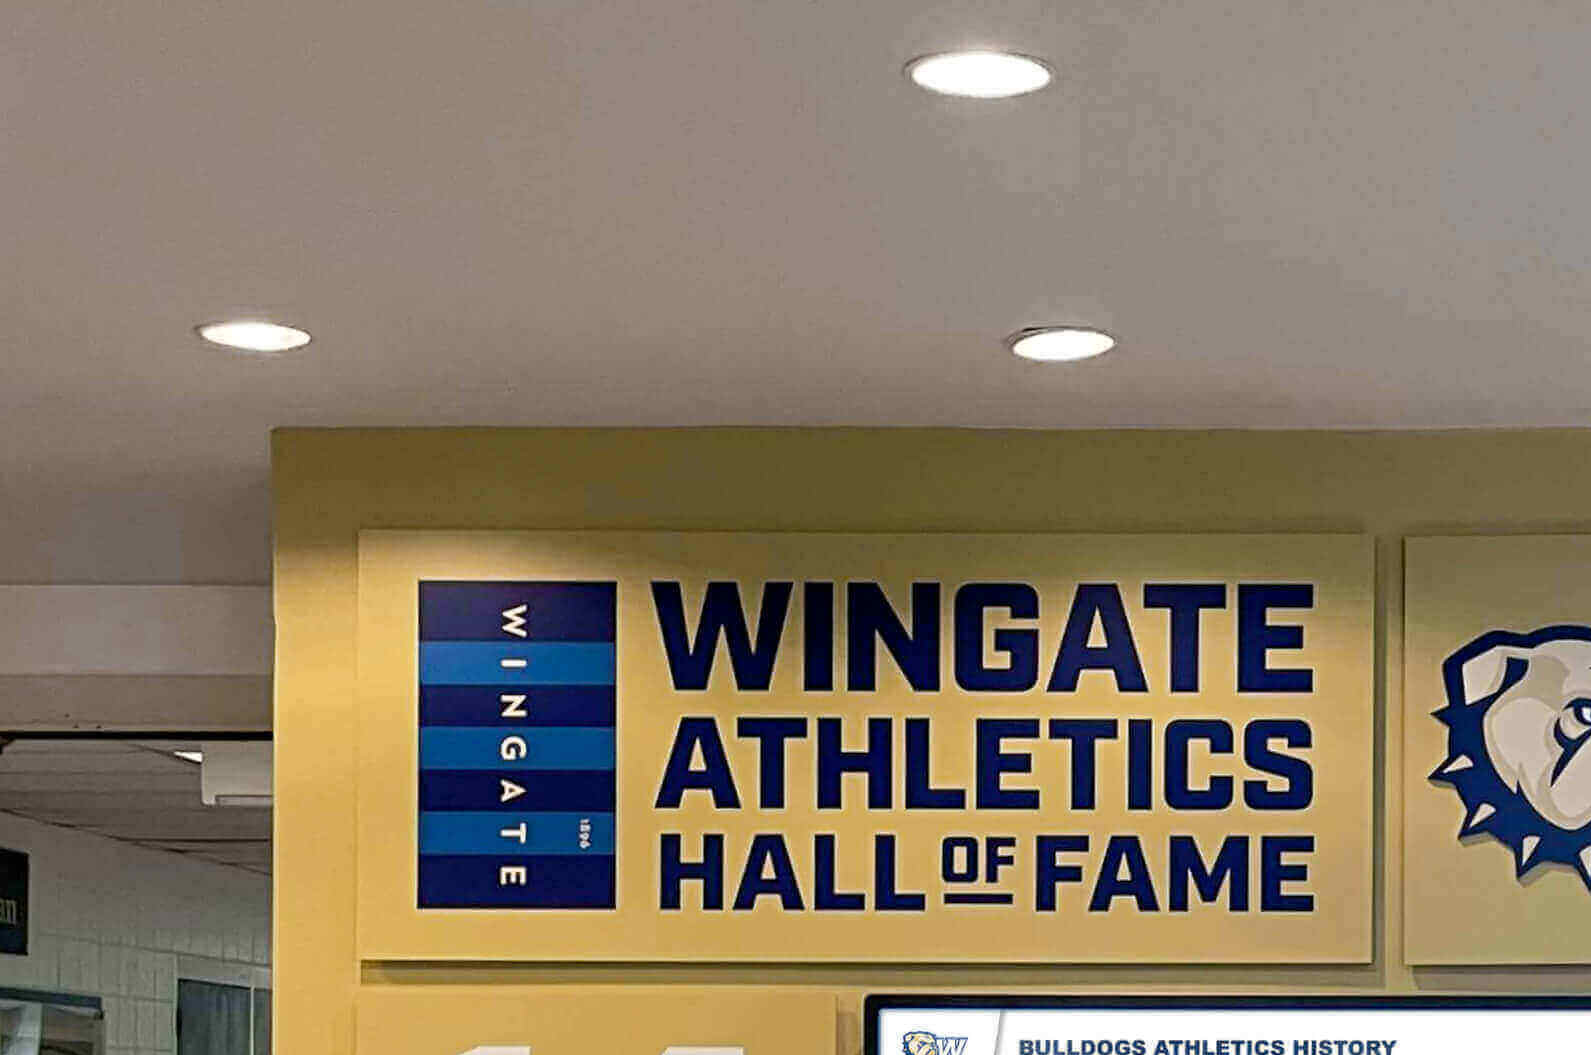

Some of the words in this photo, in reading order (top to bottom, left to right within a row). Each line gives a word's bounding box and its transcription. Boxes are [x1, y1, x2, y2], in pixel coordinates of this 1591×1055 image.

[650, 580, 1314, 694] WINGATE
[500, 603, 528, 886] WINGATE
[655, 716, 1314, 811] ATHLETICS
[660, 833, 926, 911] HALL
[941, 835, 1015, 884] OF
[1035, 834, 1315, 912] FAME
